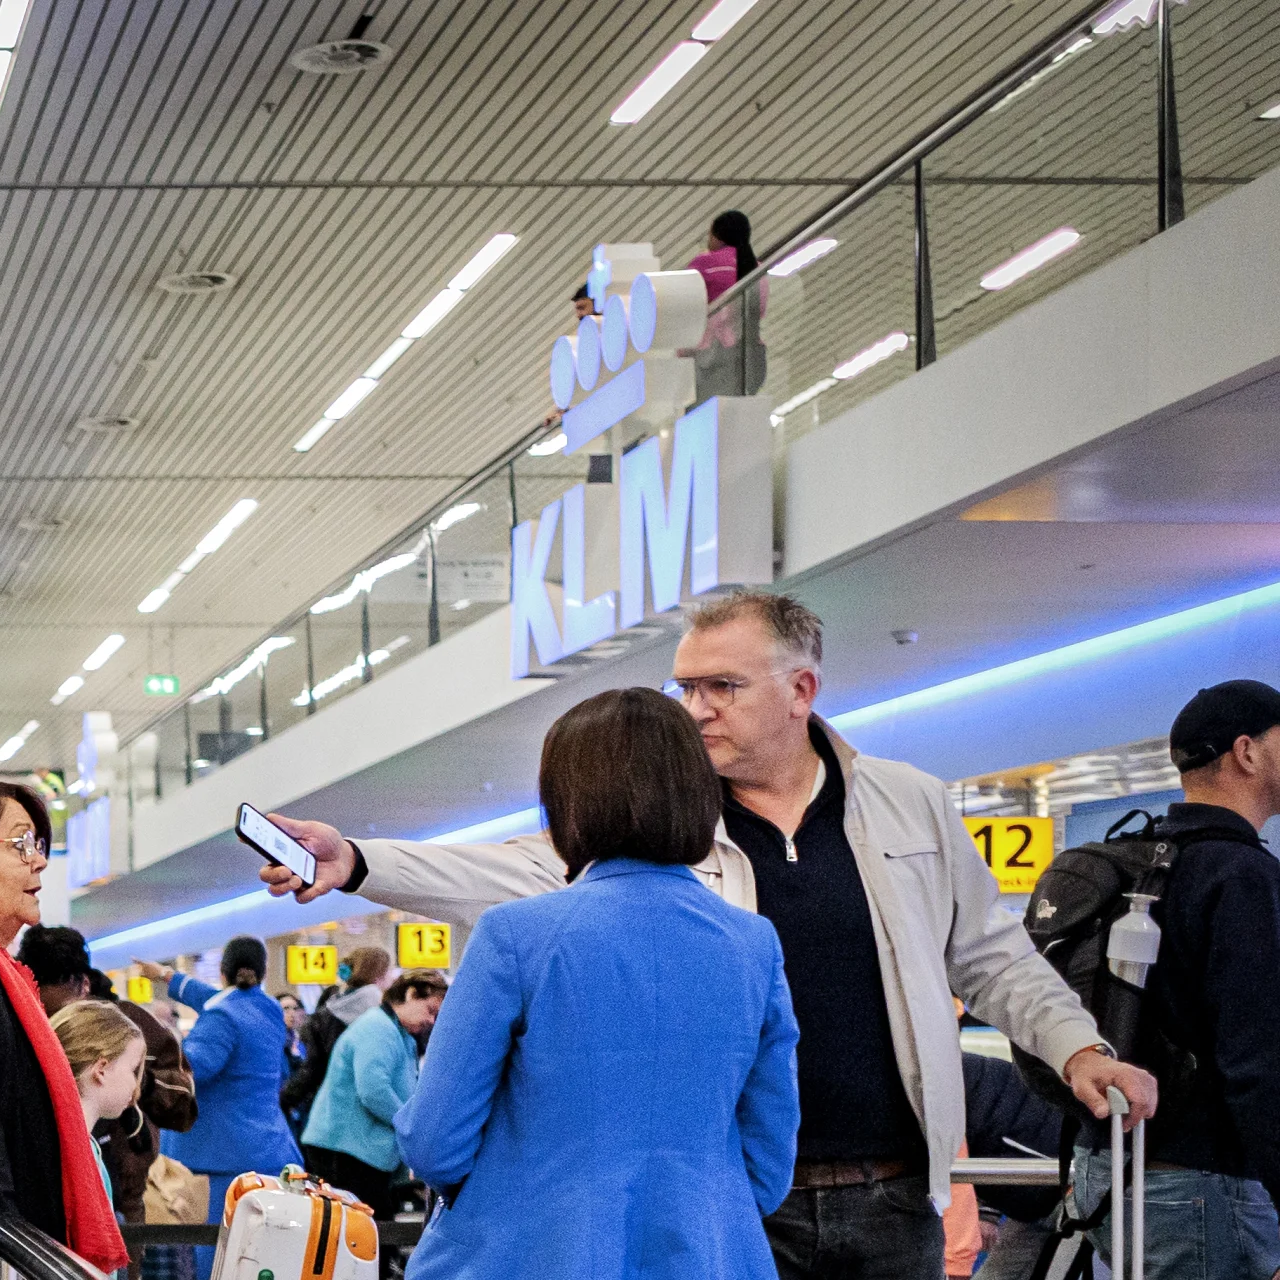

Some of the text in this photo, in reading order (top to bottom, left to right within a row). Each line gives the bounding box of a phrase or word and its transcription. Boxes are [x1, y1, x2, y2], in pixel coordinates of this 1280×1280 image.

[511, 396, 719, 680] KLM
[973, 824, 1035, 868] 12
[412, 929, 445, 954] 13
[299, 951, 327, 970] 14
